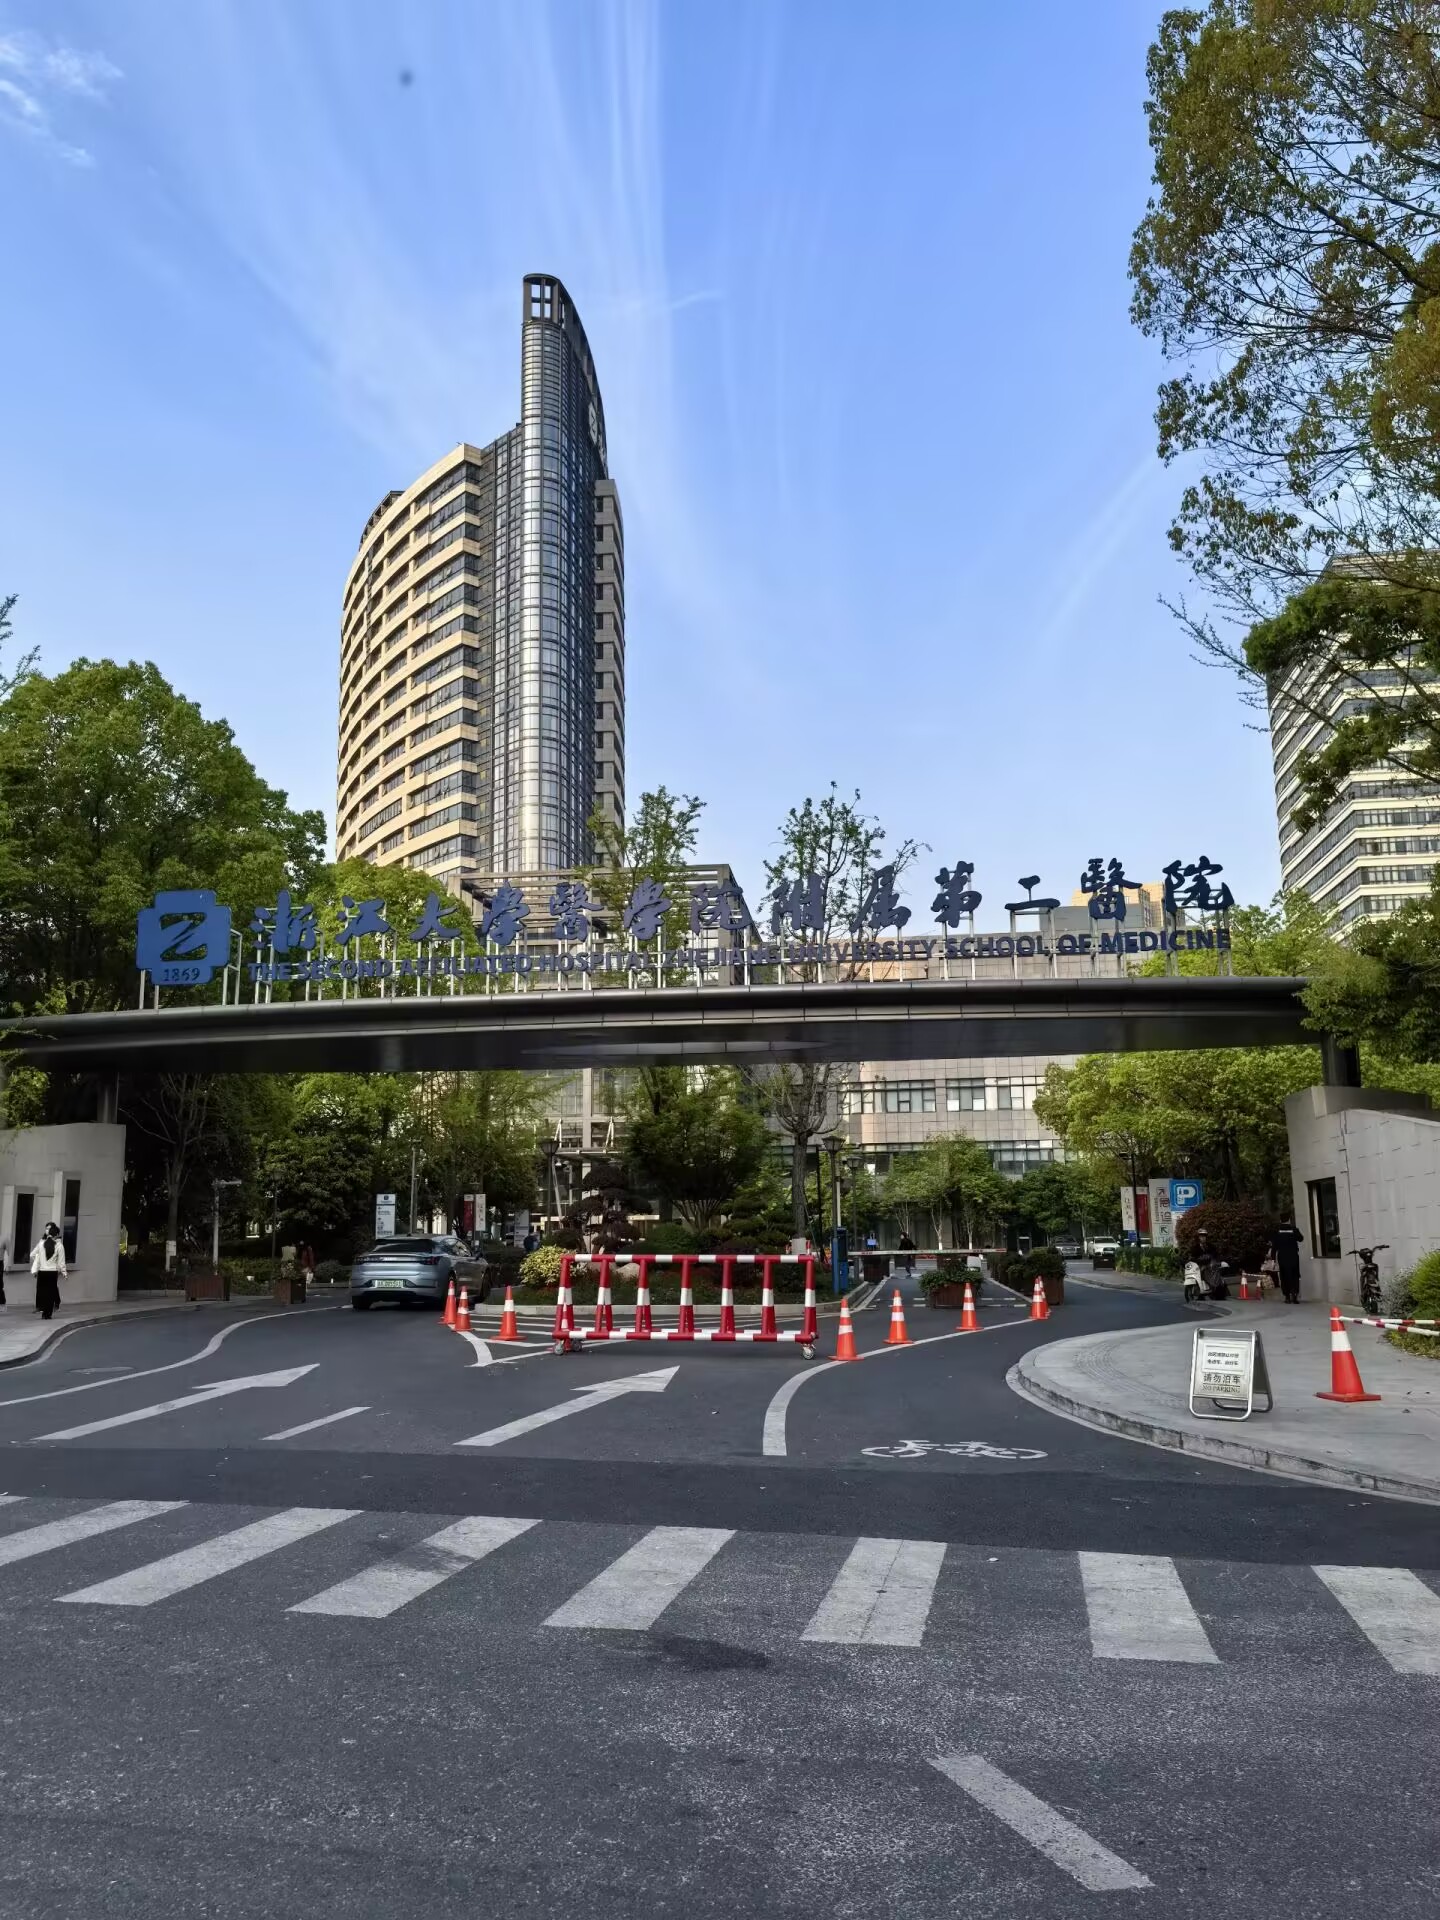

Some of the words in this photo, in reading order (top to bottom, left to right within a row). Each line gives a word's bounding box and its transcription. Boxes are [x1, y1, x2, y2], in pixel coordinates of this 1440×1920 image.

[249, 962, 291, 982] THE
[299, 959, 394, 982] SECOND
[400, 953, 532, 977] AFFILIATED
[539, 951, 653, 973] HOSPITAL
[661, 945, 782, 968] ZHEJIANG
[788, 938, 937, 962] UNIVERSITY
[945, 935, 1048, 958] SCHOOL
[1058, 934, 1093, 954] OF
[1100, 928, 1231, 954] MEDICINE
[163, 967, 200, 982] 1869
[1177, 1186, 1196, 1205] P
